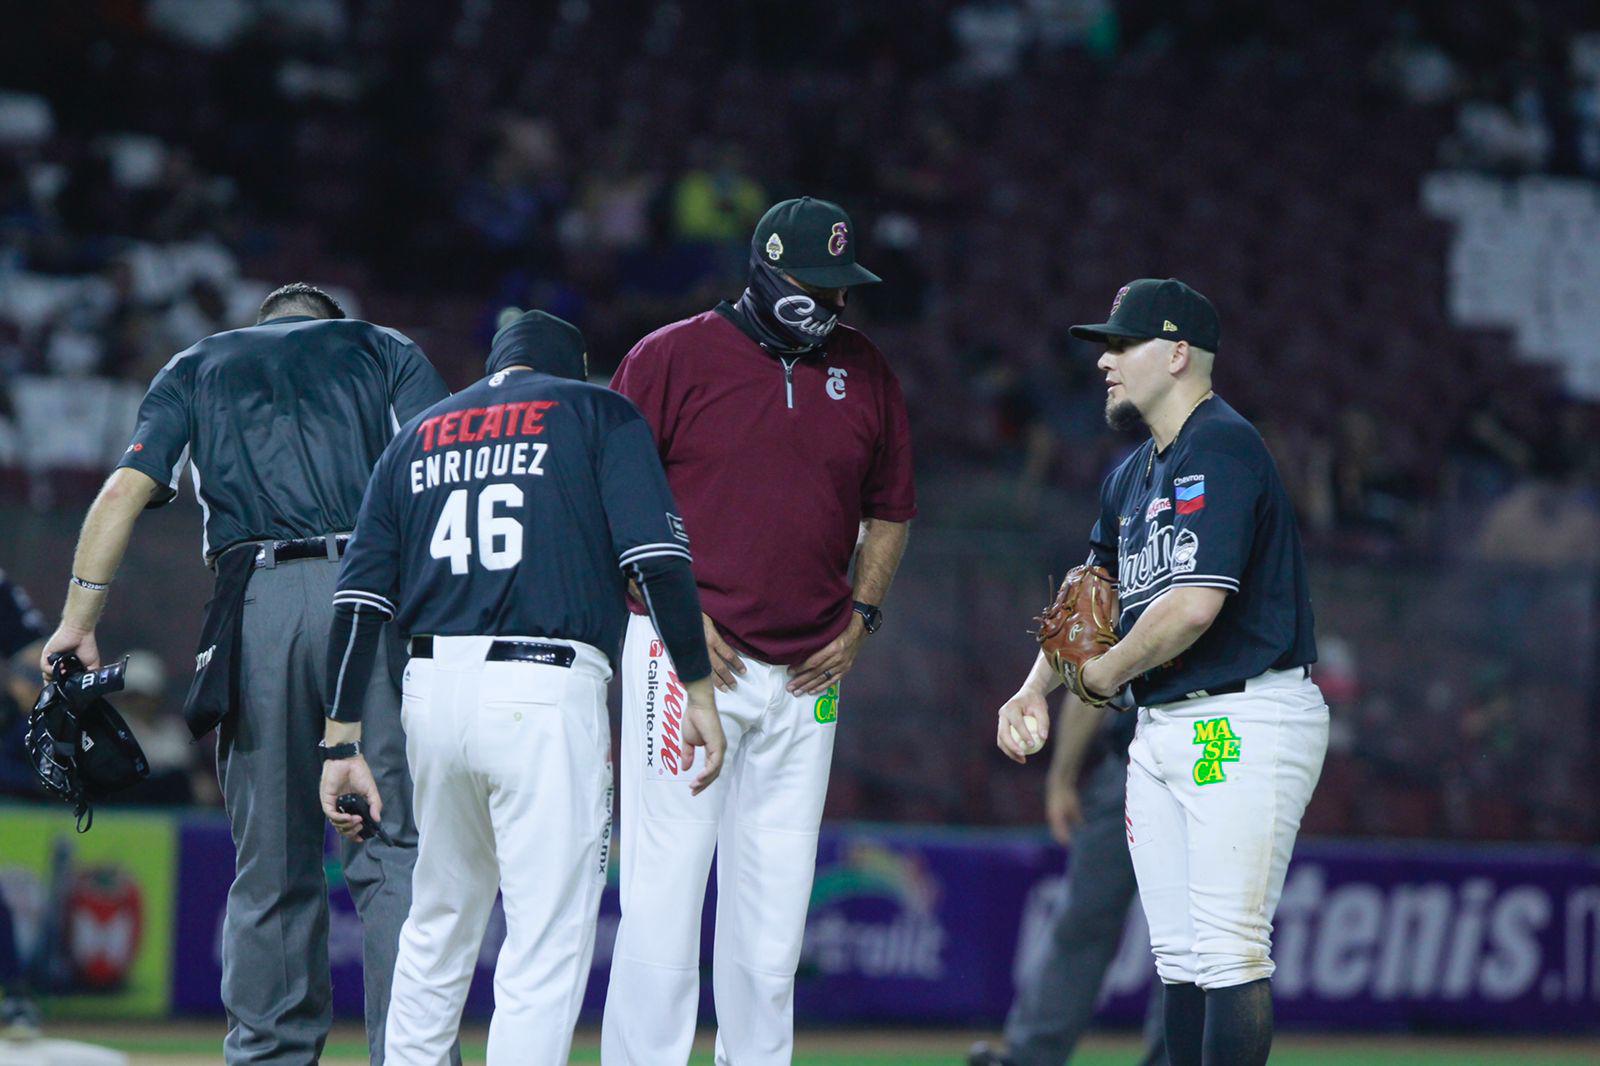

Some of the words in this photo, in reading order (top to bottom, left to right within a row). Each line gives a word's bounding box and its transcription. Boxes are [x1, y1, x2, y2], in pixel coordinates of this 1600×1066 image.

[416, 401, 560, 452] TECATE
[410, 442, 549, 494] ENRIQUEZ
[1173, 474, 1205, 487] Chevron
[429, 482, 525, 576] 46
[645, 659, 659, 768] caliente.mx
[1194, 718, 1234, 744] MA
[1204, 739, 1241, 762] SE
[1193, 760, 1225, 785] CA
